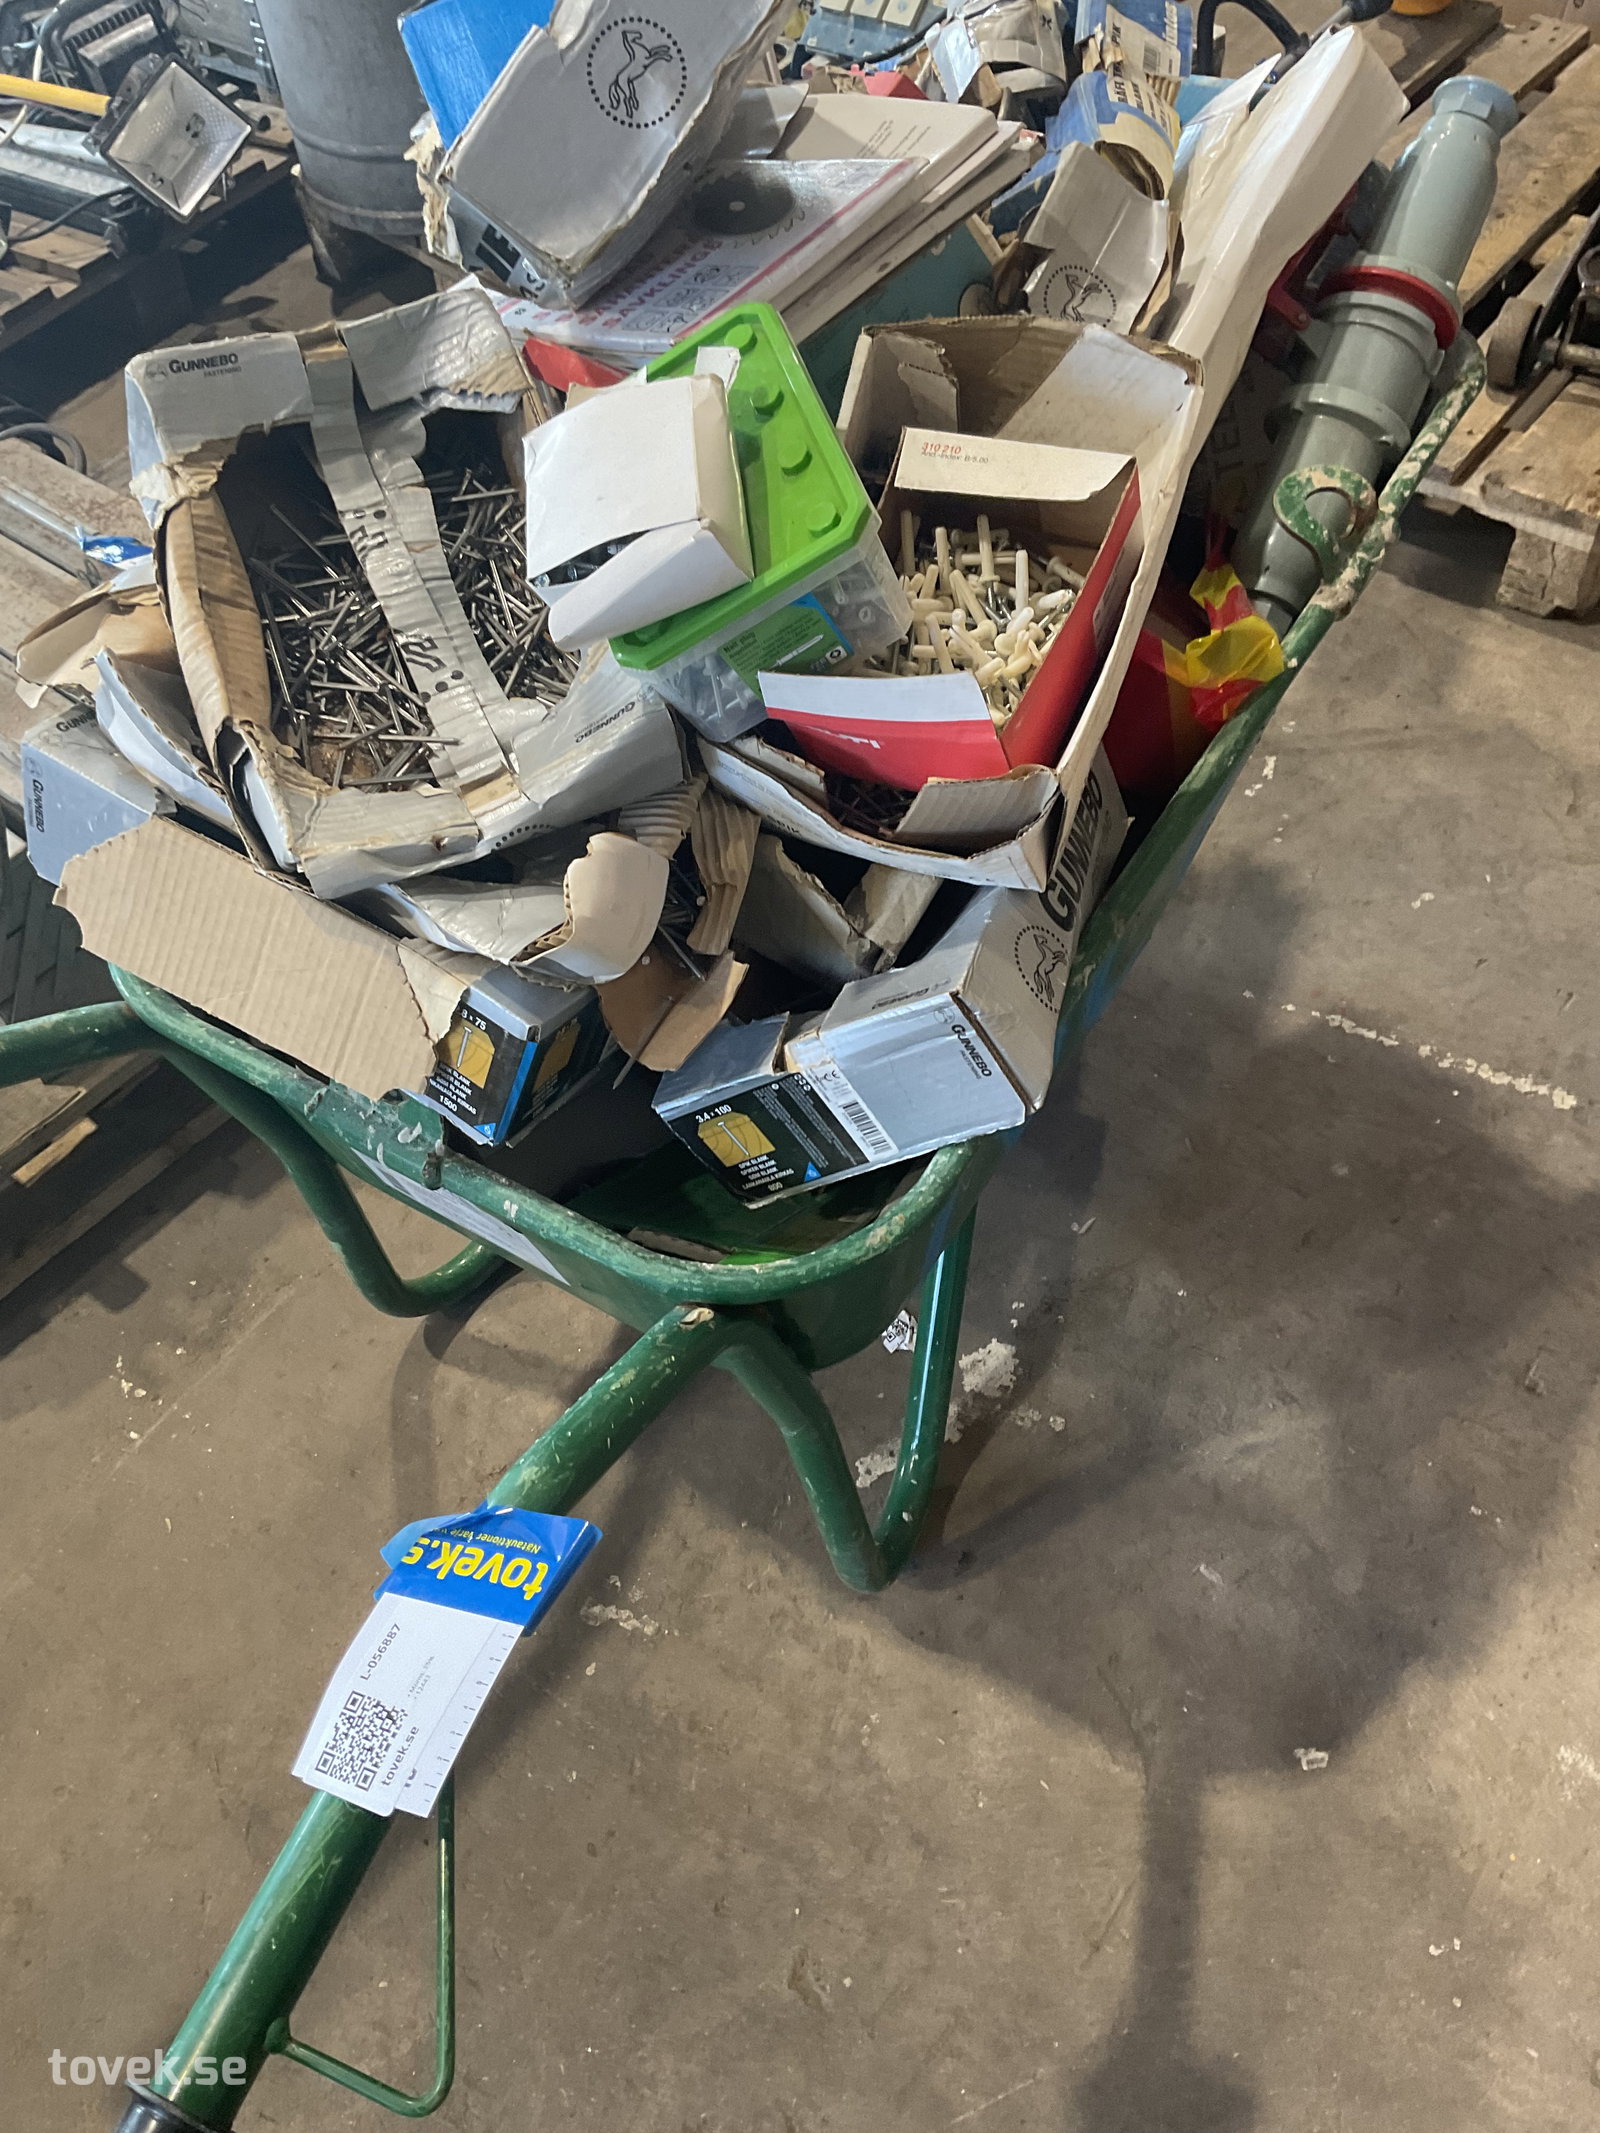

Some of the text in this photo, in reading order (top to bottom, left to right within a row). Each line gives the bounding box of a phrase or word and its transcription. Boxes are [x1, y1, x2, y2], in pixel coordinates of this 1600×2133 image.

[168, 352, 239, 374] GUNNEBO
[575, 701, 636, 743] GUNNEBO
[32, 778, 45, 833] GUNNEBO
[1038, 769, 1103, 932] GUNNEBO
[475, 1016, 487, 1031] 75
[951, 1024, 992, 1077] GUNNEBO
[440, 1095, 458, 1112] 1500
[714, 1103, 733, 1116] 100
[475, 1532, 542, 1555] Nätauktioner
[359, 1622, 401, 1681] L-056887
[381, 1726, 420, 1787] tovek.se
